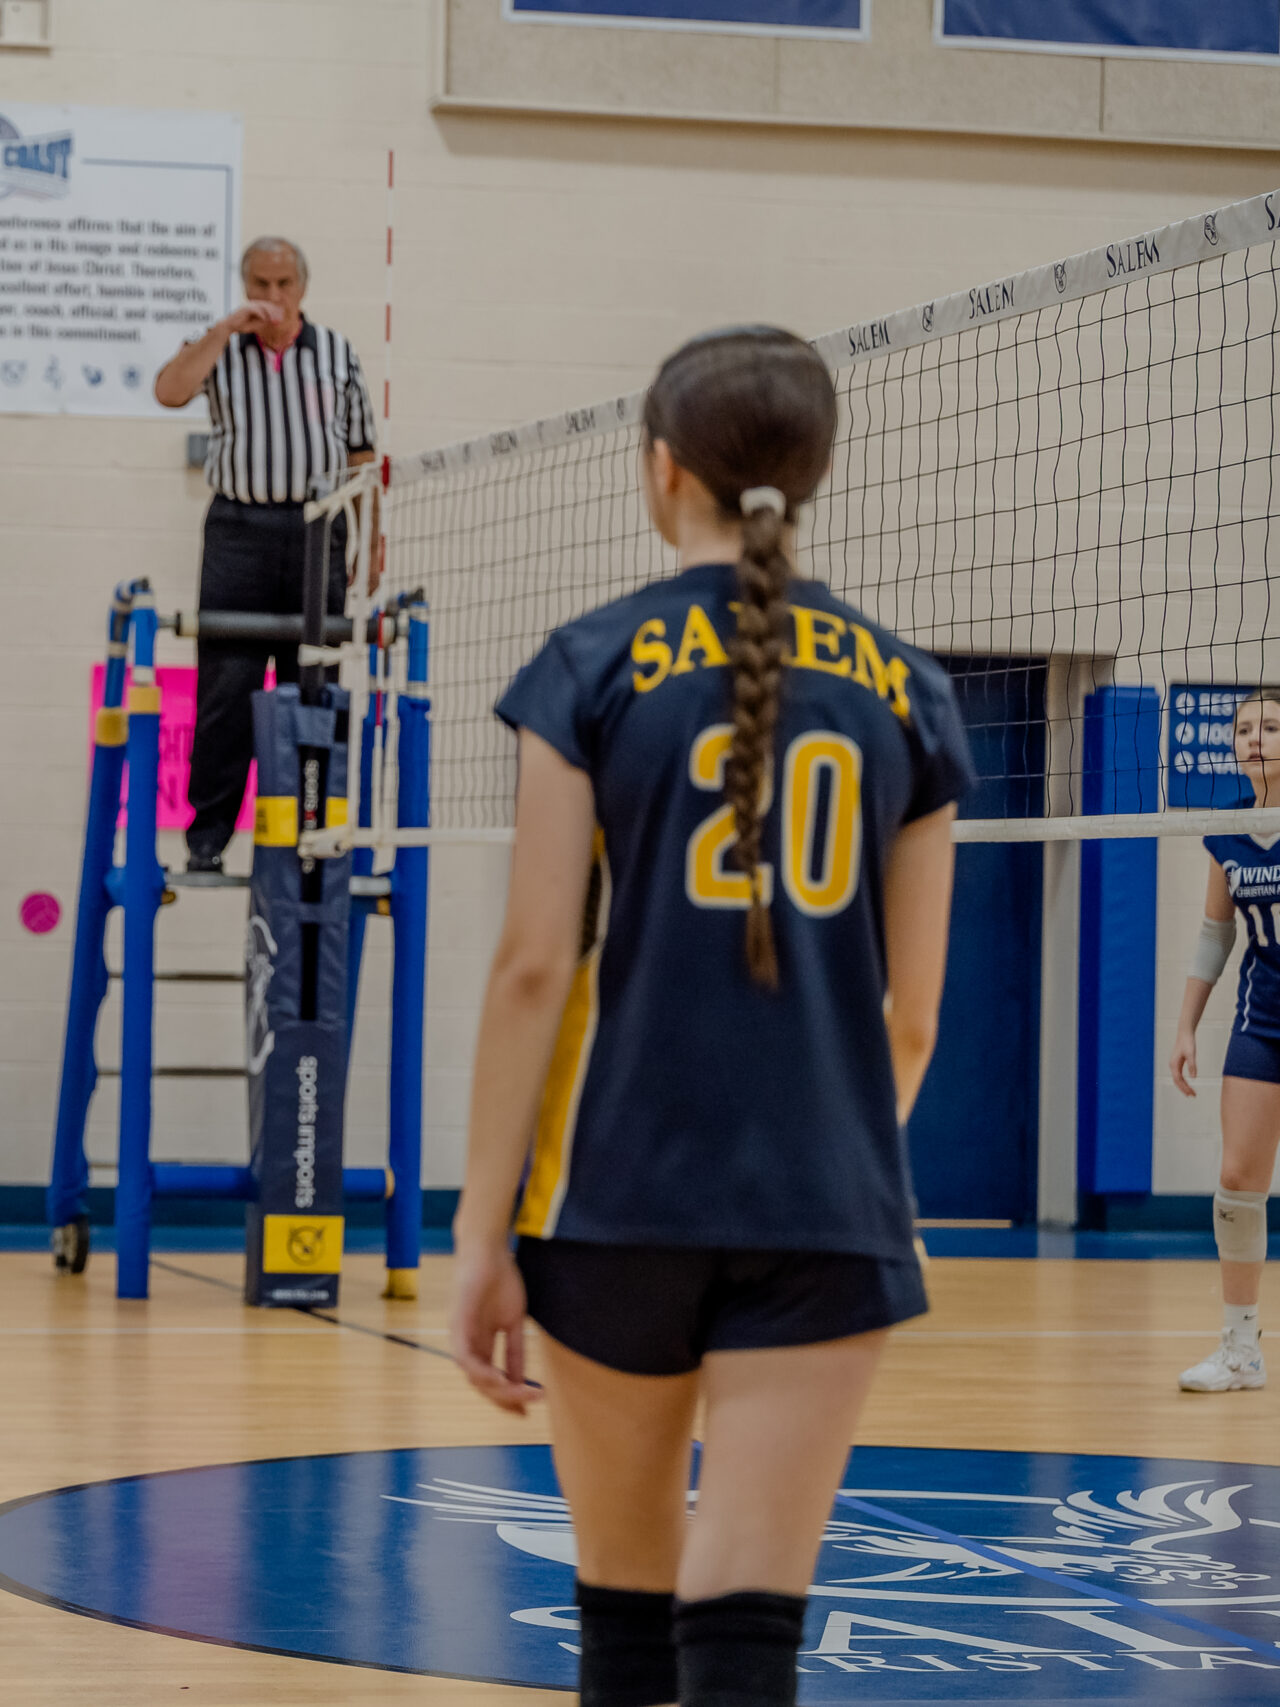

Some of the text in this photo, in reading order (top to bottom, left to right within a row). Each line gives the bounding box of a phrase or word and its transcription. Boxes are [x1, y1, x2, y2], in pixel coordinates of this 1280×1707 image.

[3, 136, 73, 180] COAST
[1105, 235, 1161, 278] SALEM
[968, 280, 1016, 320] SALEM
[848, 320, 892, 357] SALEM
[631, 602, 910, 718] SAEM
[685, 723, 864, 918] 20
[1236, 884, 1275, 898] CHRISTIAN
[1242, 865, 1280, 884] WIND
[292, 1056, 319, 1208] sports imports
[796, 1651, 1280, 1674] RISTIA
